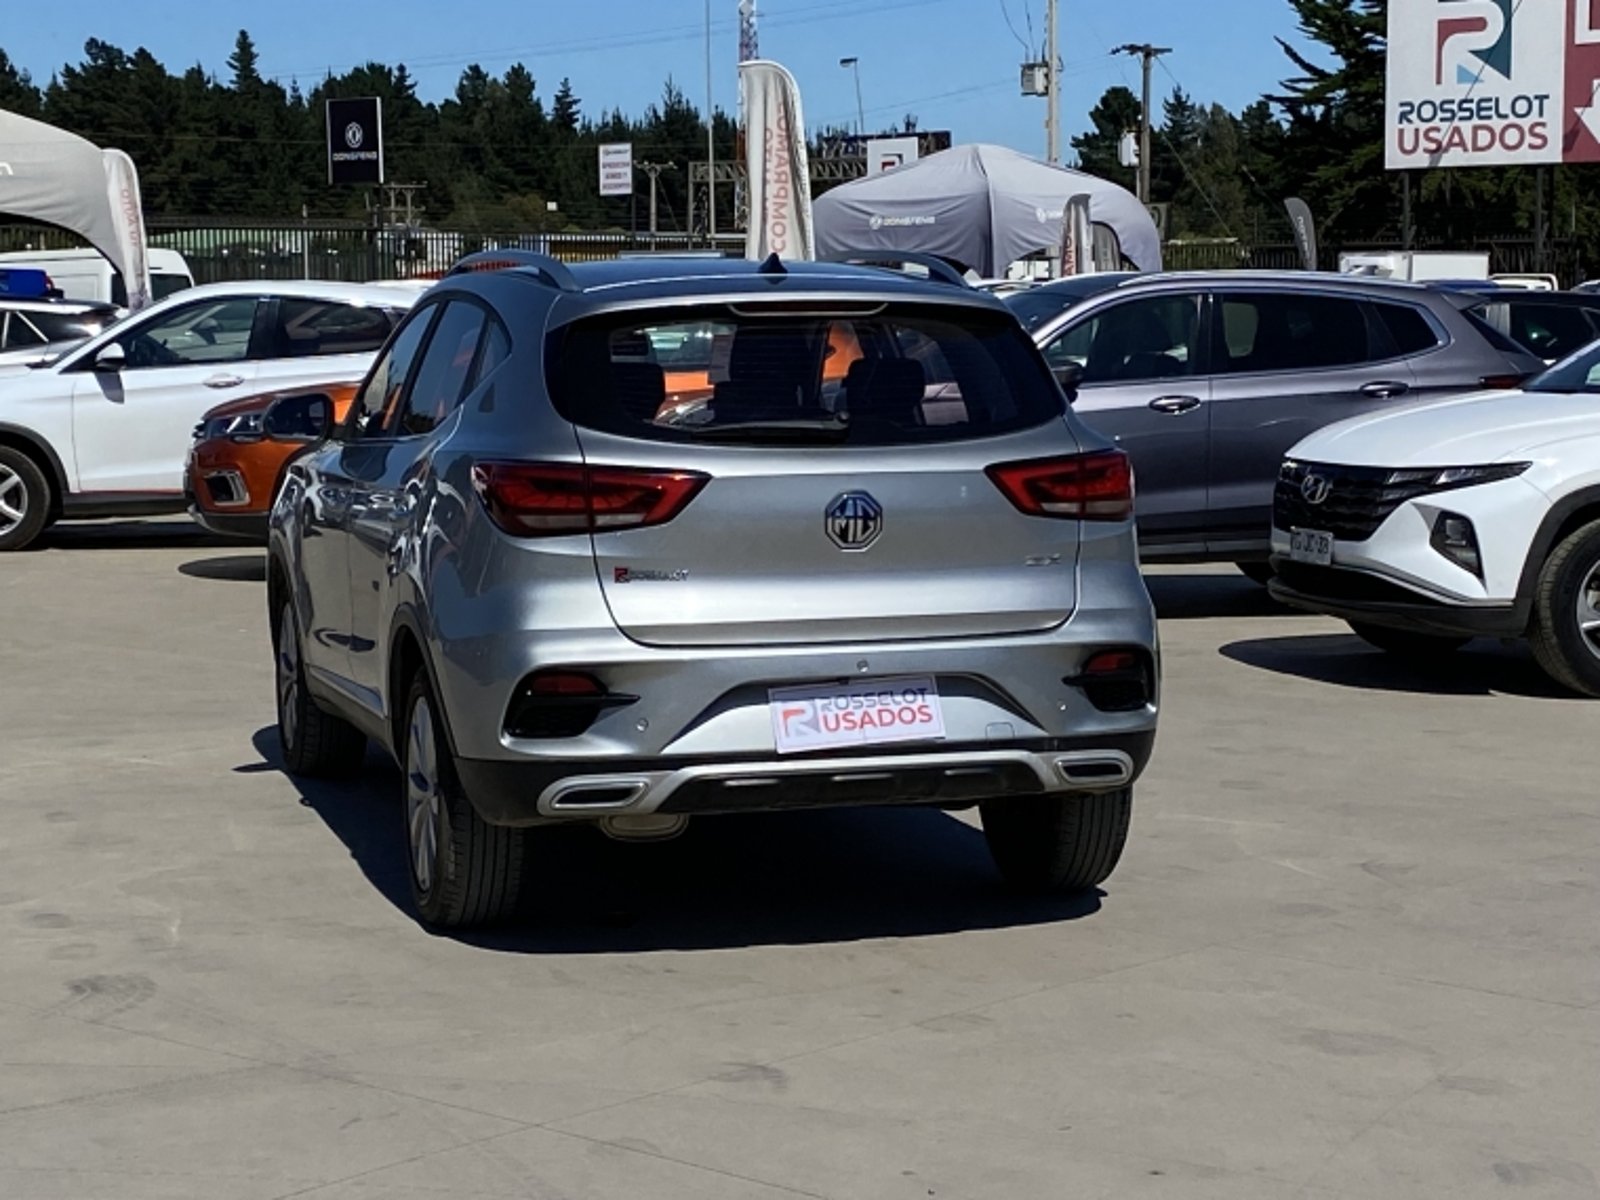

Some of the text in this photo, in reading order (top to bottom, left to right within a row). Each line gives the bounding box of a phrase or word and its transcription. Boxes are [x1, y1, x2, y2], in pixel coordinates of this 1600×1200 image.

[1398, 94, 1550, 124] ROSSELOT
[1397, 122, 1549, 156] USADOS
[820, 687, 928, 712] ROSSELOT
[822, 704, 933, 732] USADOS
